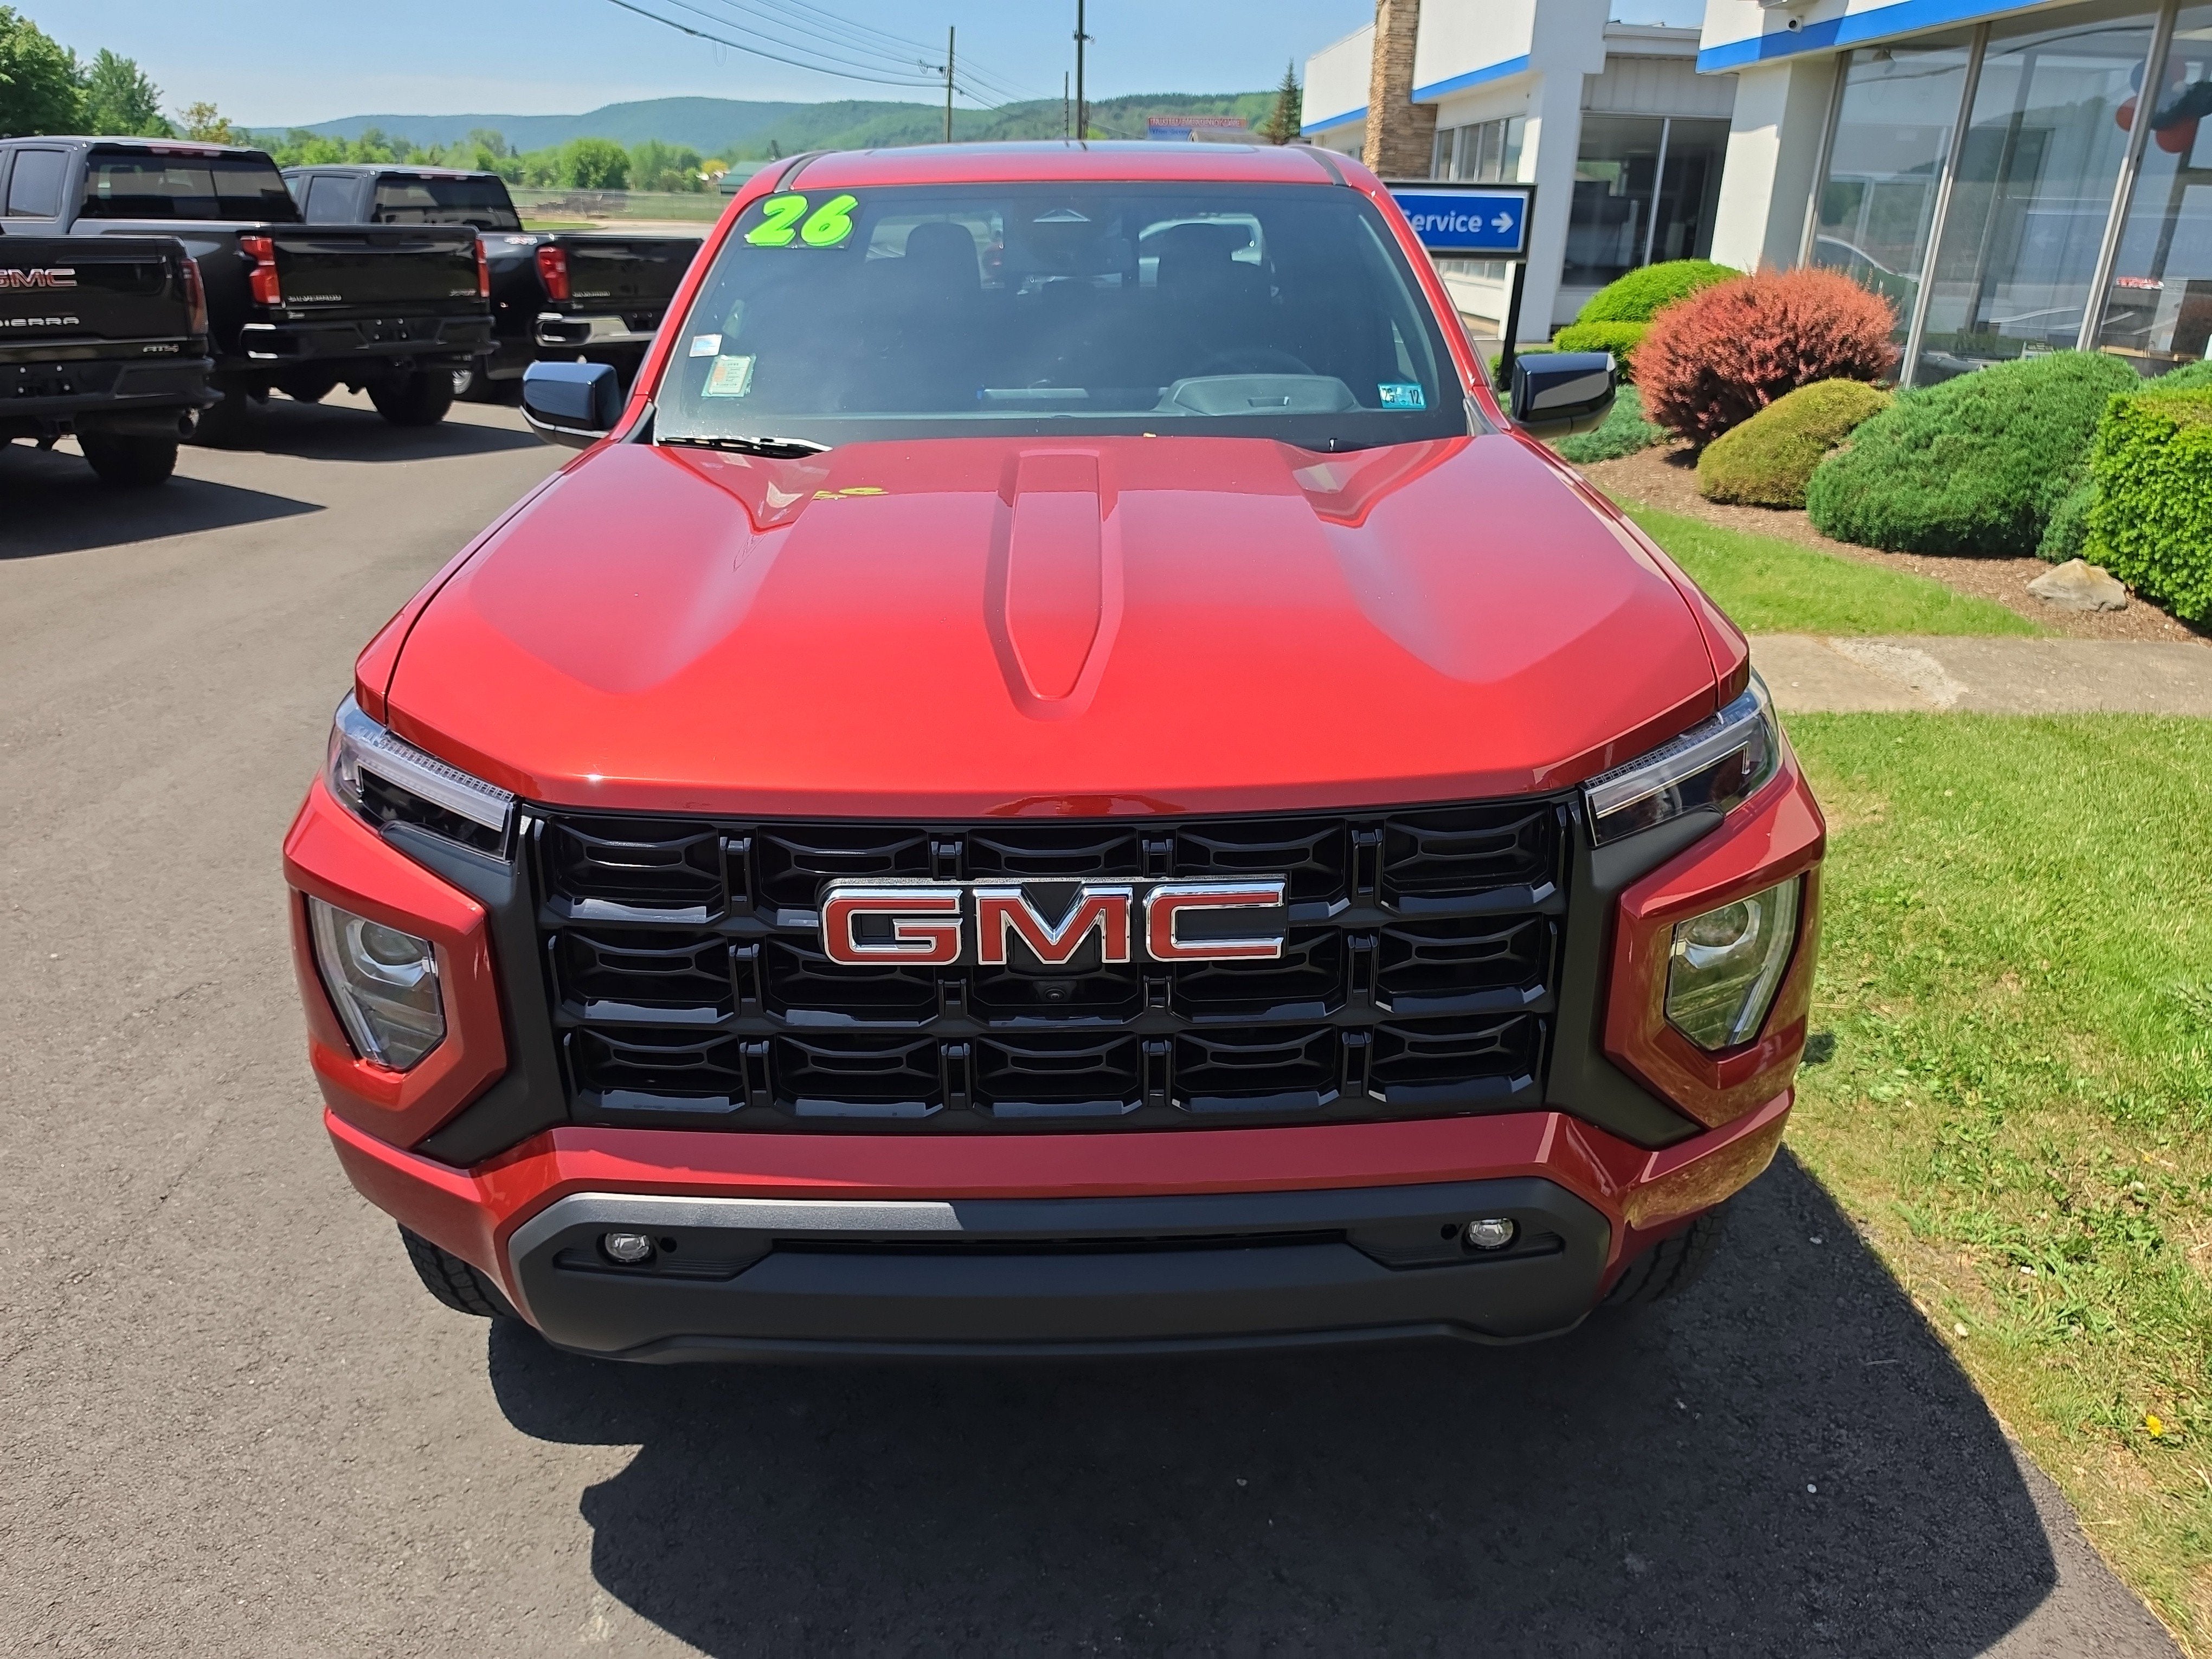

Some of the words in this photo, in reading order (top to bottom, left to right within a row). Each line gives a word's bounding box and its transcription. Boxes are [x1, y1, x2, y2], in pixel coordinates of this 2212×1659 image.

[744, 194, 859, 247] 26
[0, 317, 80, 326] IERRA
[1409, 390, 1422, 405] 12
[821, 881, 1285, 966] GMC
